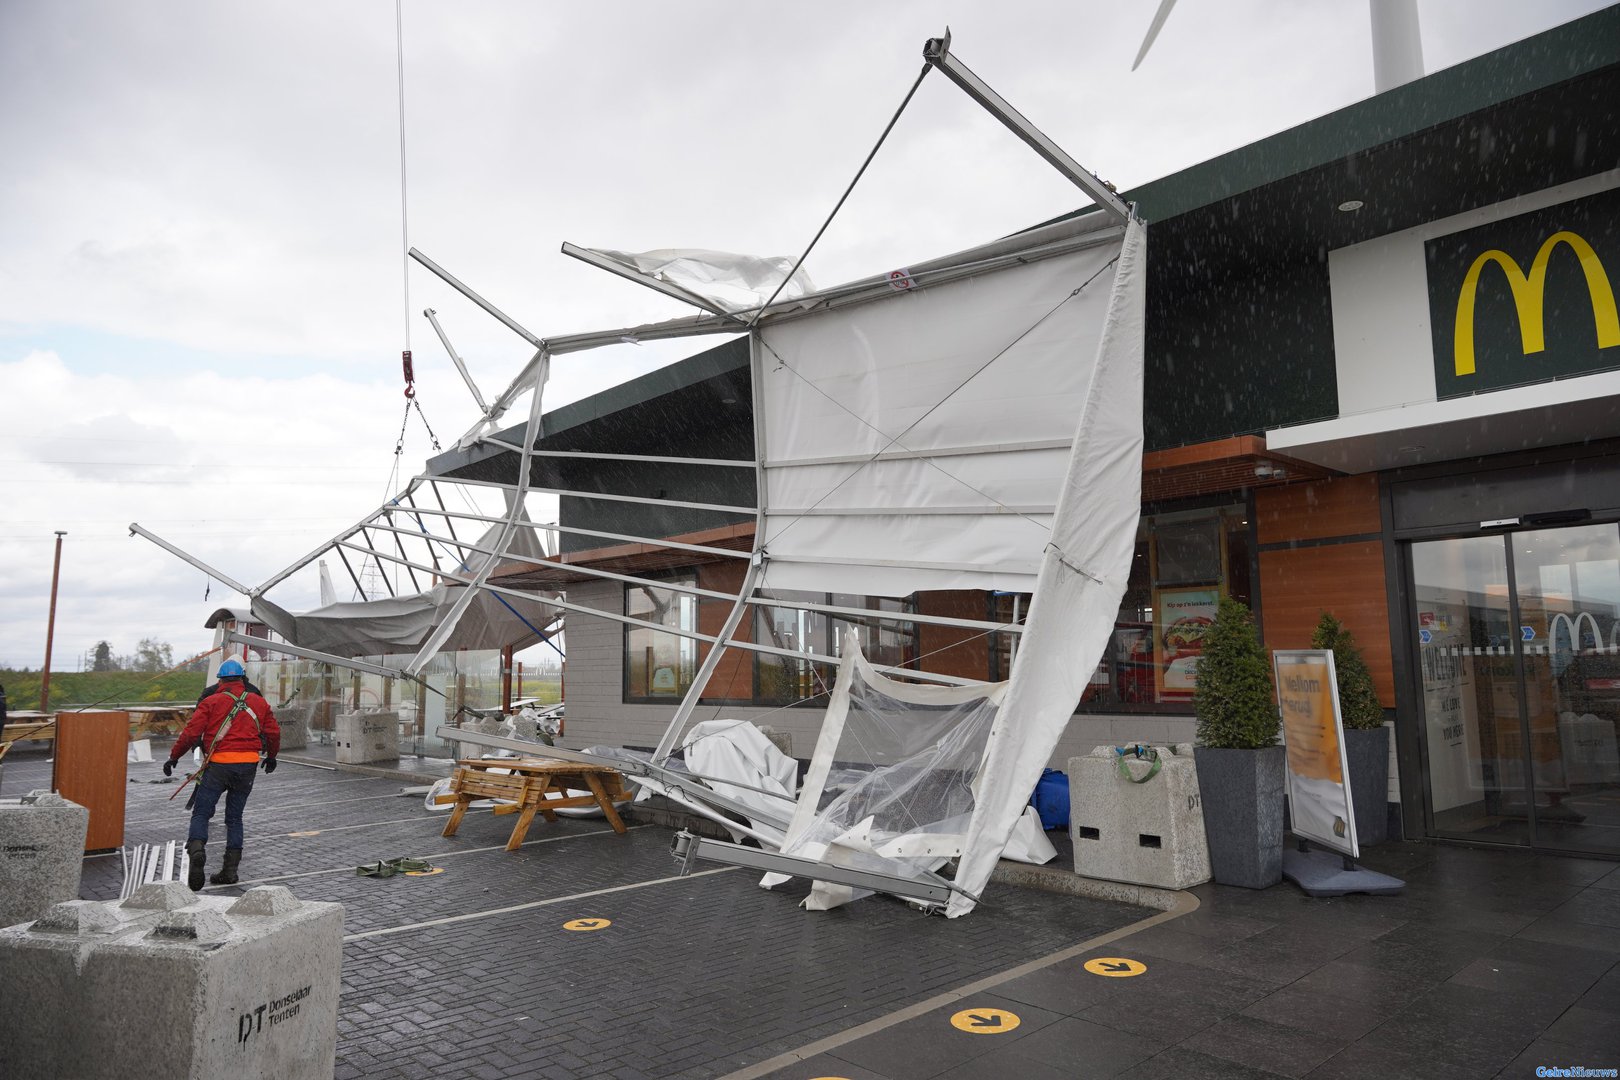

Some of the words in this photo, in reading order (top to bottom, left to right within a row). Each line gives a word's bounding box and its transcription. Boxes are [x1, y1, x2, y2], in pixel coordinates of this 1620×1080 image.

[1188, 794, 1199, 810] DT
[8, 852, 36, 860] enten
[269, 985, 312, 1014] Donselaar
[238, 1004, 267, 1044] DT
[269, 1004, 300, 1028] Tenten
